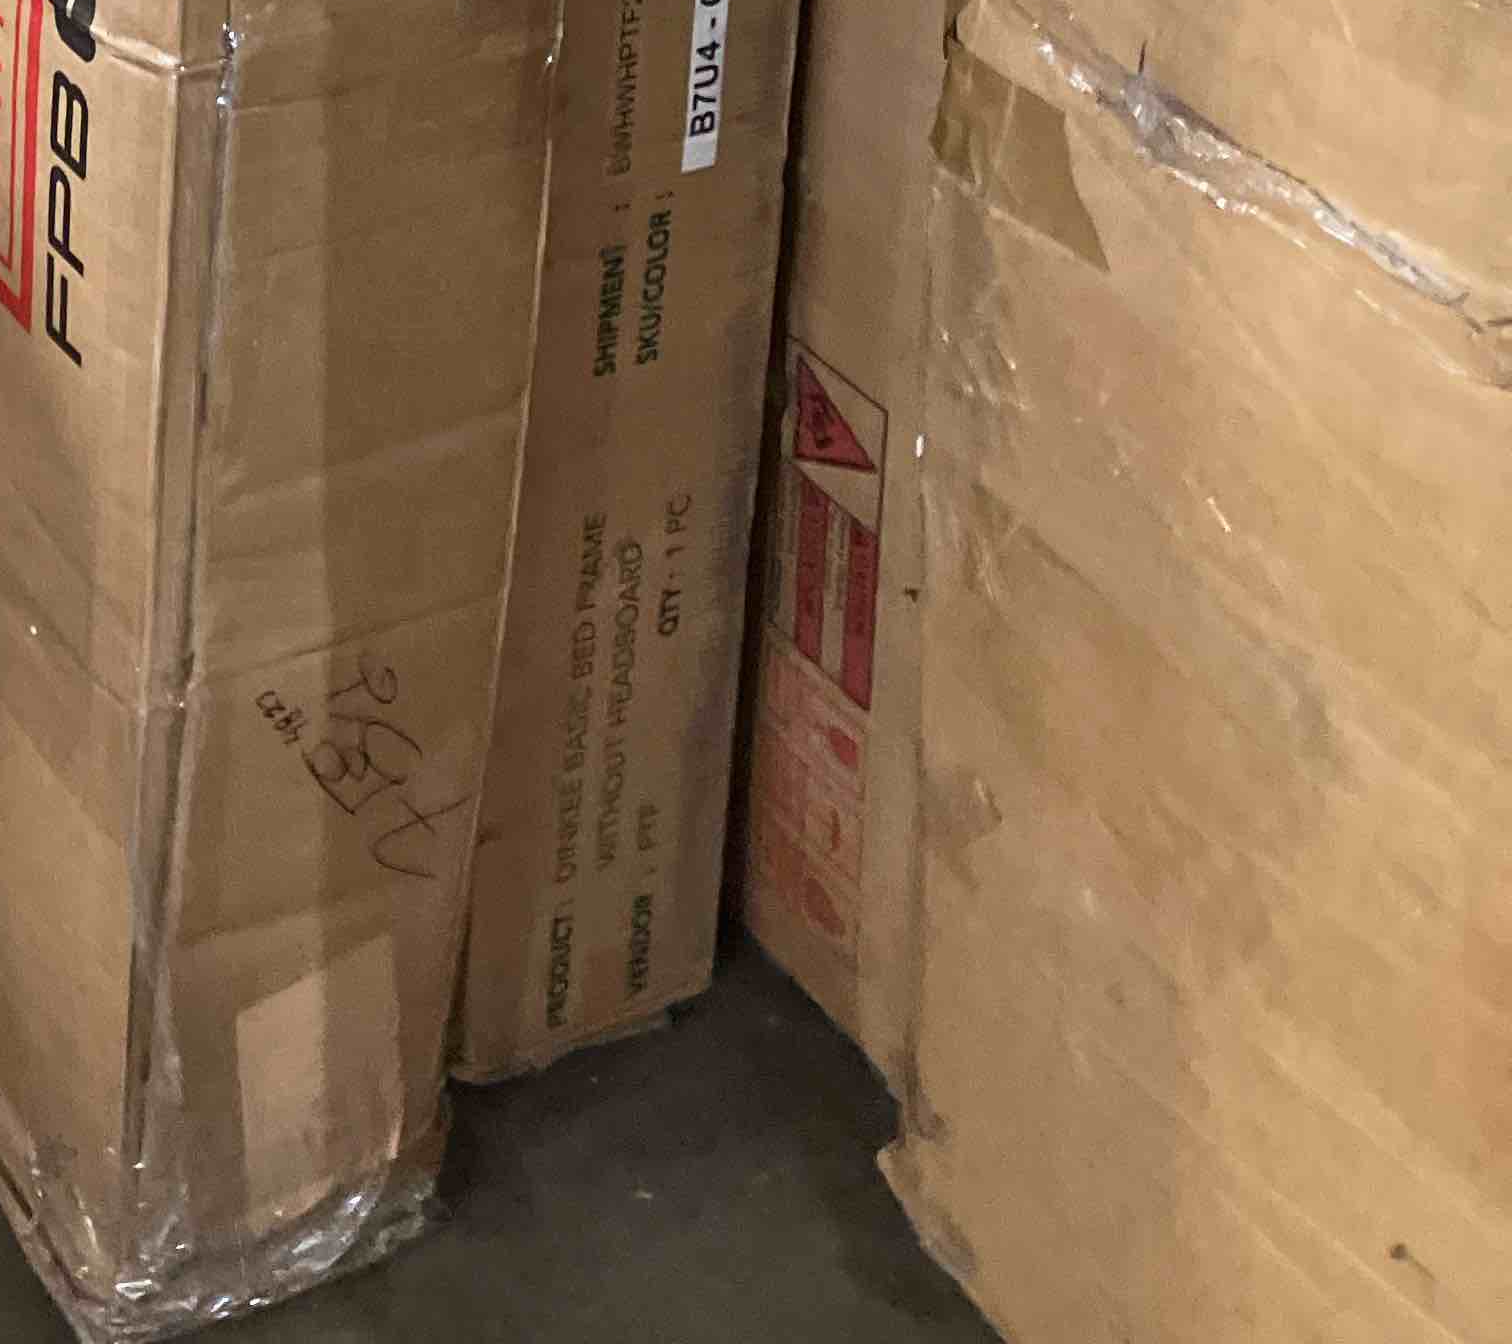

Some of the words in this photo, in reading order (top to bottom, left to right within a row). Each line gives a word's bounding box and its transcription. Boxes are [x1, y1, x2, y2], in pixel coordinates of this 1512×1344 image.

[688, 40, 722, 138] B7U4
[45, 71, 90, 368] FPB
[592, 246, 626, 377] SHIPMENT
[635, 209, 672, 366] SKU/COLOR
[576, 513, 607, 612] FRAME
[664, 495, 690, 534] PC
[571, 621, 597, 682] BED
[605, 541, 643, 729] HEADBOARD
[657, 589, 682, 638] QTY
[593, 736, 626, 869] WITHOUT
